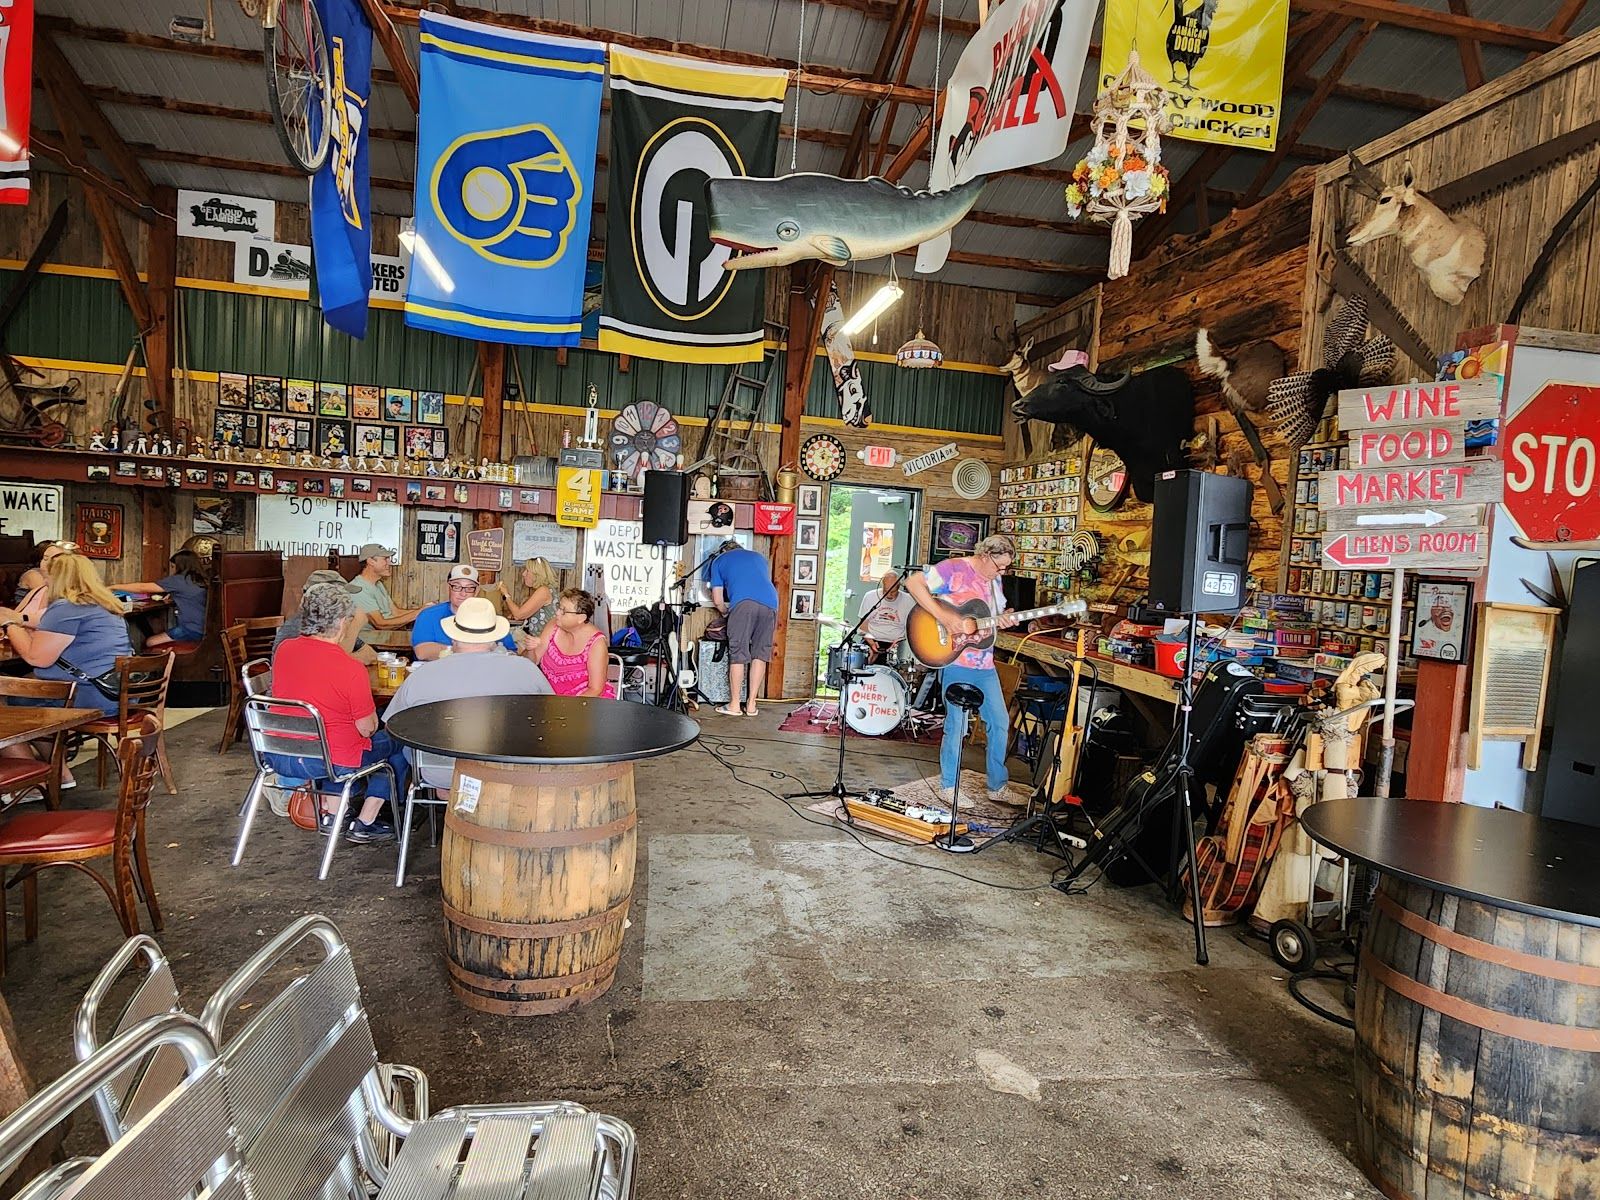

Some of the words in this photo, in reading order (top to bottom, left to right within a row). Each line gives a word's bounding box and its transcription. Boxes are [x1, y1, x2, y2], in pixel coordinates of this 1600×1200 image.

[1185, 17, 1198, 28] THE
[1172, 25, 1208, 40] JAMAICAN
[1174, 35, 1201, 54] DOOR
[1198, 97, 1275, 118] WOOD
[1169, 113, 1271, 139] CHICKEN
[201, 205, 218, 215] GET
[219, 208, 243, 219] LOUD
[205, 211, 257, 226] LAMBEAU
[371, 263, 405, 280] KERS
[640, 403, 653, 421] 12
[1362, 385, 1461, 423] WINE
[663, 423, 676, 434] 2
[662, 439, 679, 448] 3
[1359, 427, 1453, 466] FOOD
[869, 447, 892, 465] EXIT
[907, 450, 946, 472] VICTORIA
[1506, 433, 1598, 498] STO
[566, 468, 593, 502] 4
[1336, 467, 1473, 506] MARKET
[3, 490, 56, 512] WAKE
[82, 508, 116, 523] PABST
[335, 500, 371, 520] FINE
[317, 520, 343, 540] FOR
[420, 523, 438, 533] SERVE
[438, 524, 445, 533] IT
[609, 524, 641, 538] DEPO
[424, 532, 439, 544] ICY
[1353, 534, 1411, 554] MENS
[1418, 531, 1479, 553] ROOM
[594, 540, 643, 560] WASTE
[610, 564, 654, 583] ONLY
[612, 585, 649, 595] PLEASE
[1206, 580, 1218, 590] 42
[1221, 582, 1233, 591] 57
[617, 598, 638, 608] AREA
[861, 682, 878, 692] THE
[851, 690, 888, 704] CHERRY
[868, 703, 898, 717] TONES
